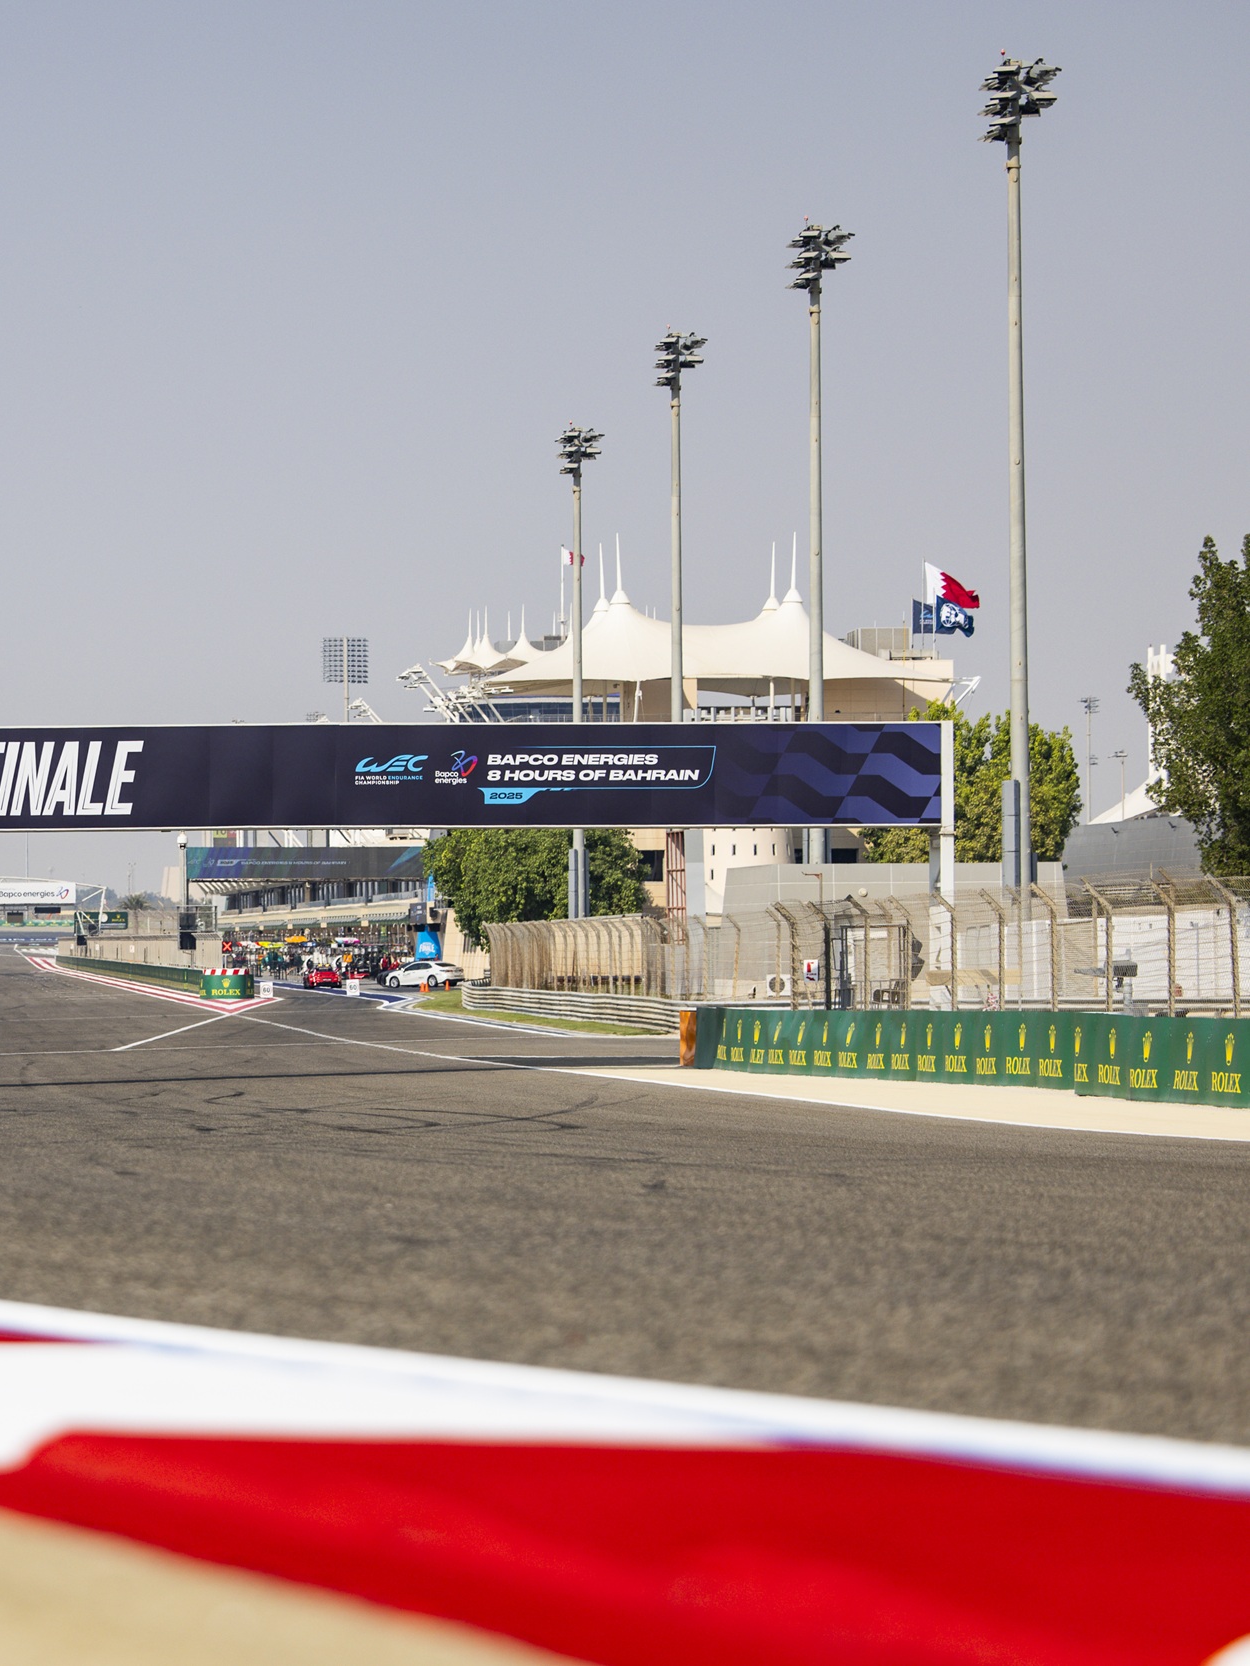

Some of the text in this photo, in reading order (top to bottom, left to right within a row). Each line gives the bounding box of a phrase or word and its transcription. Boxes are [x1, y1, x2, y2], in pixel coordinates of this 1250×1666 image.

[355, 754, 429, 772] WEC
[487, 753, 659, 765] BAPCO ENERGIES
[435, 770, 459, 778] Bapco
[487, 769, 700, 781] 8 HOURS OF BAHRAIN
[435, 777, 468, 785] energies
[22, 890, 55, 898] energies
[211, 988, 241, 996] ROLEX
[945, 1055, 967, 1073] ROLEX
[976, 1057, 997, 1075] ROLEX
[1005, 1056, 1031, 1075] ROLEX
[1039, 1059, 1063, 1077] ROLEX
[1074, 1063, 1089, 1083] LEX
[1097, 1064, 1121, 1086] ROLEX
[1129, 1068, 1158, 1088] ROLEX
[1173, 1070, 1199, 1091] ROLEX
[1211, 1071, 1242, 1094] ROLEX
